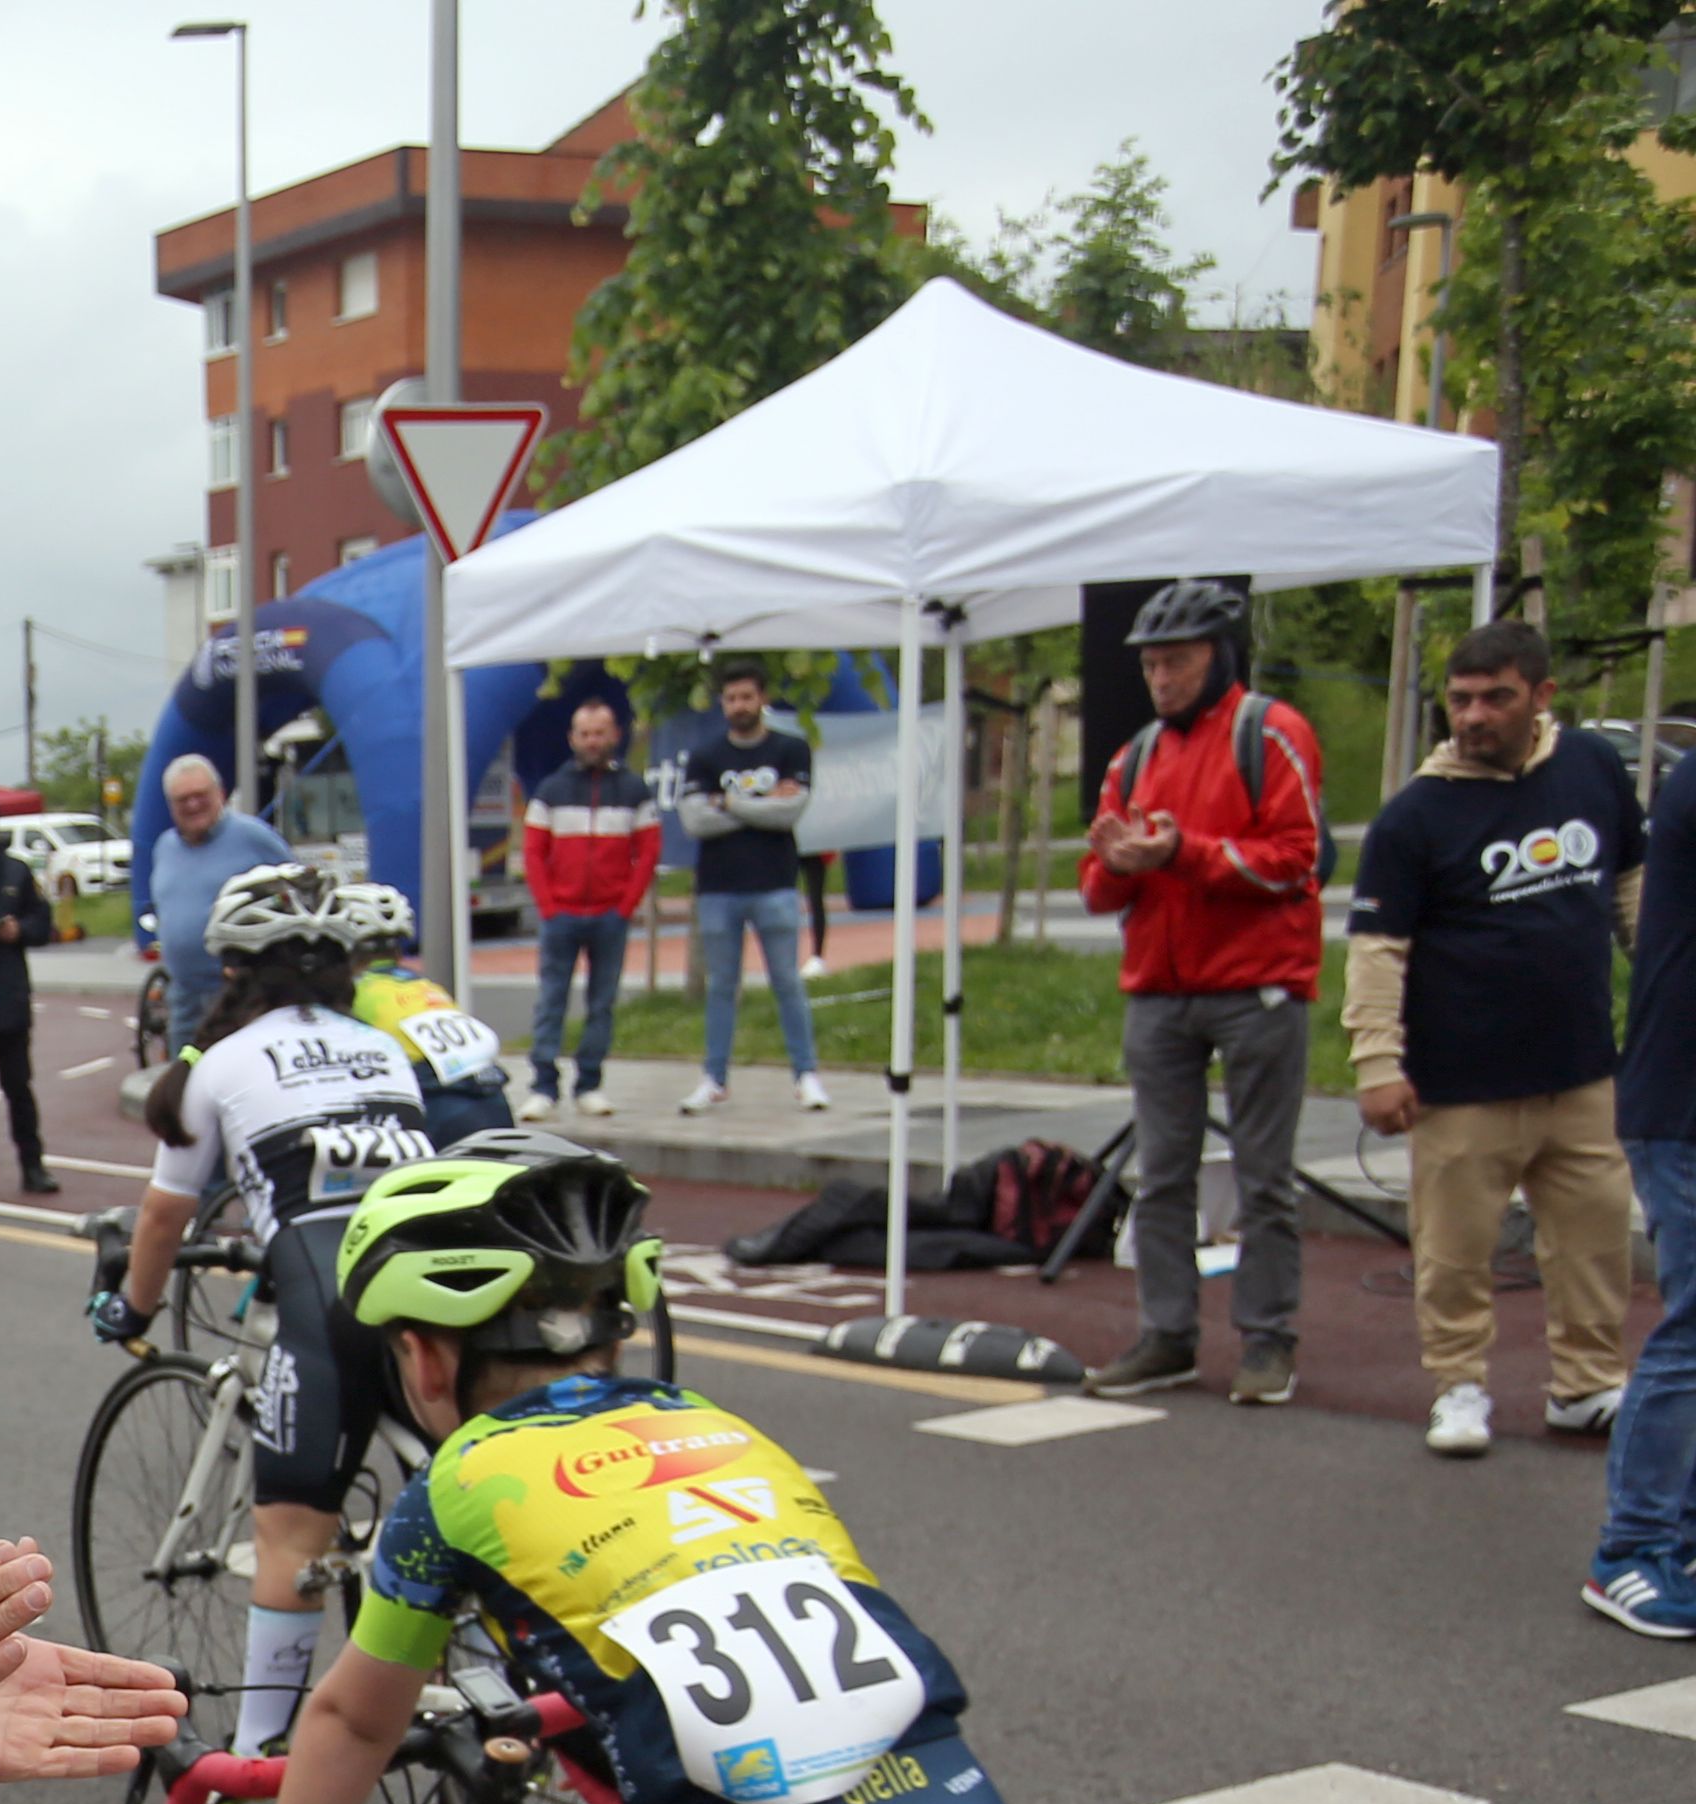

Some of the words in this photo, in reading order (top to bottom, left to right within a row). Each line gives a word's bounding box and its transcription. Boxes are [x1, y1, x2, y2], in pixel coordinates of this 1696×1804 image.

[1481, 818, 1599, 892] 200
[416, 1014, 481, 1053] 307
[574, 1430, 750, 1476] Guttrans
[648, 1580, 903, 1727] 312
